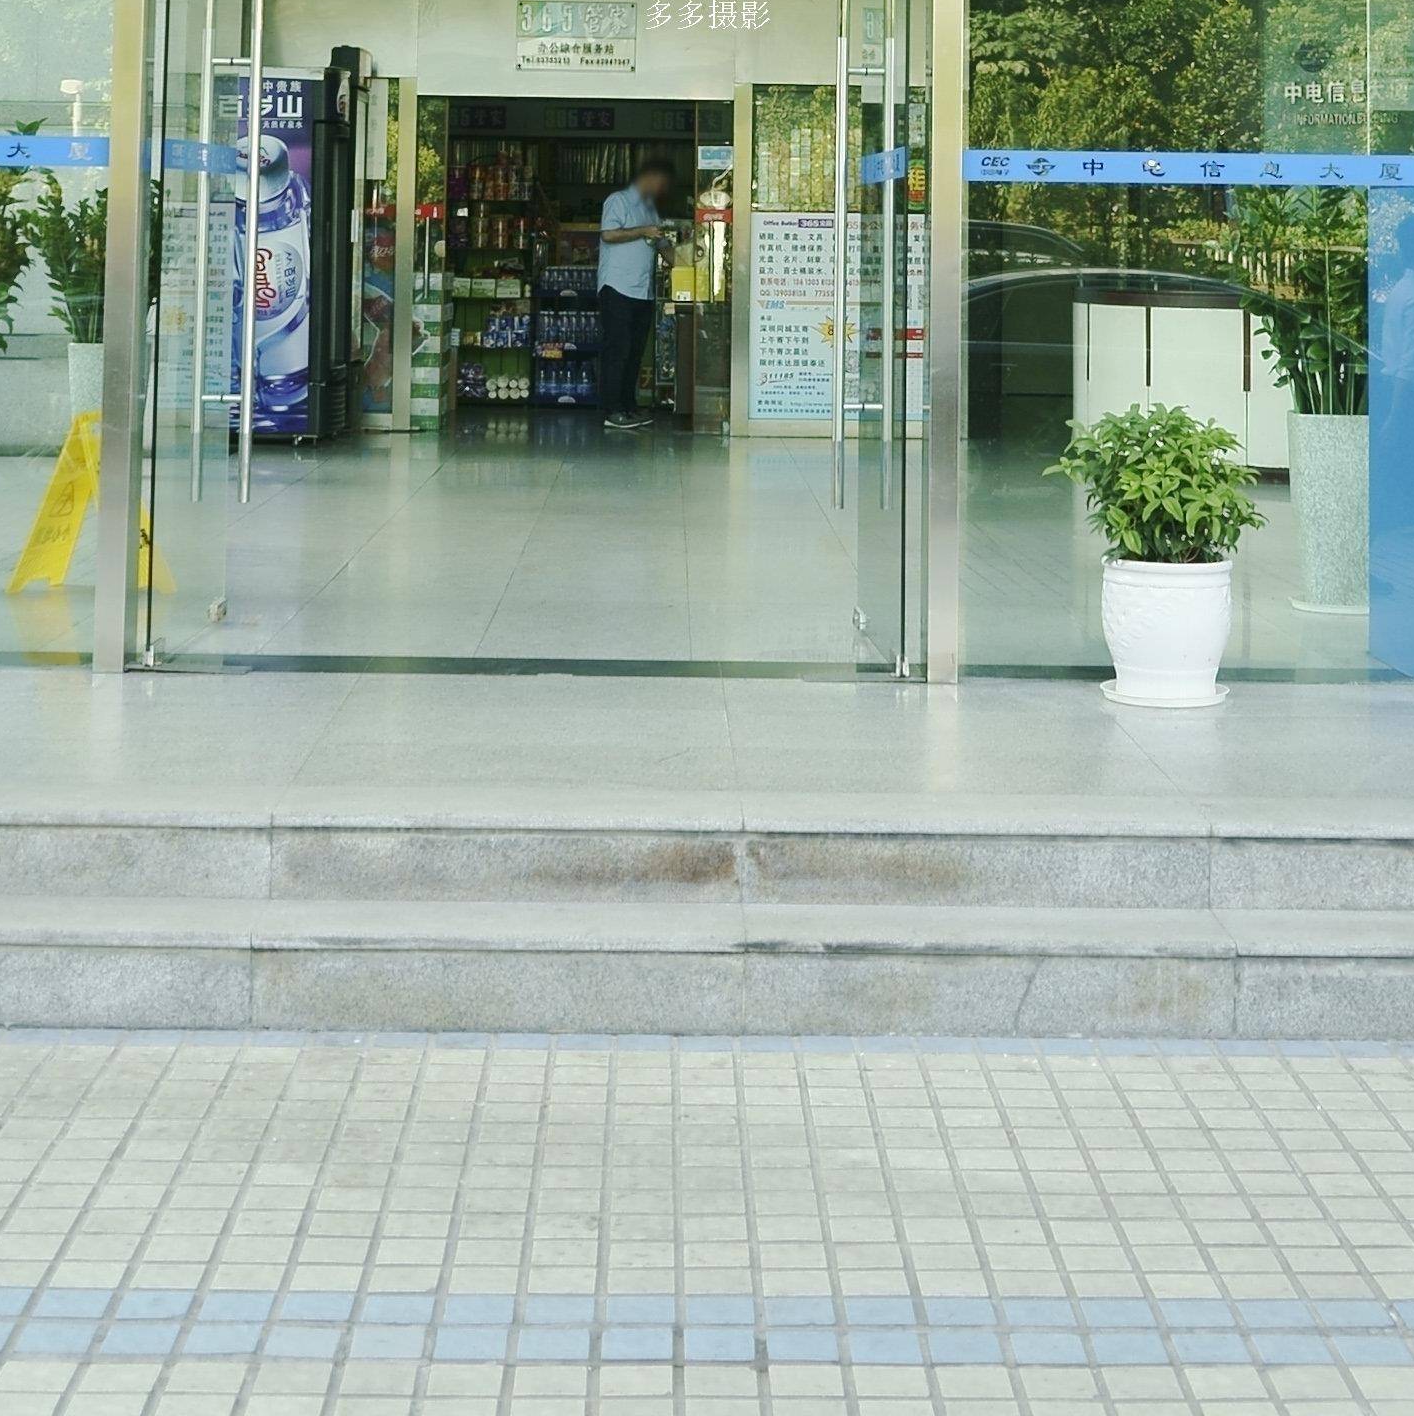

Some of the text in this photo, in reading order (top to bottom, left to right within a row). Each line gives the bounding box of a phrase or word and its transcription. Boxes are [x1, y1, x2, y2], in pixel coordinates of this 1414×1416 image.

[981, 156, 1010, 167] CEC
[1082, 157, 1404, 181] 中电信息大厦
[765, 300, 785, 309] EMS
